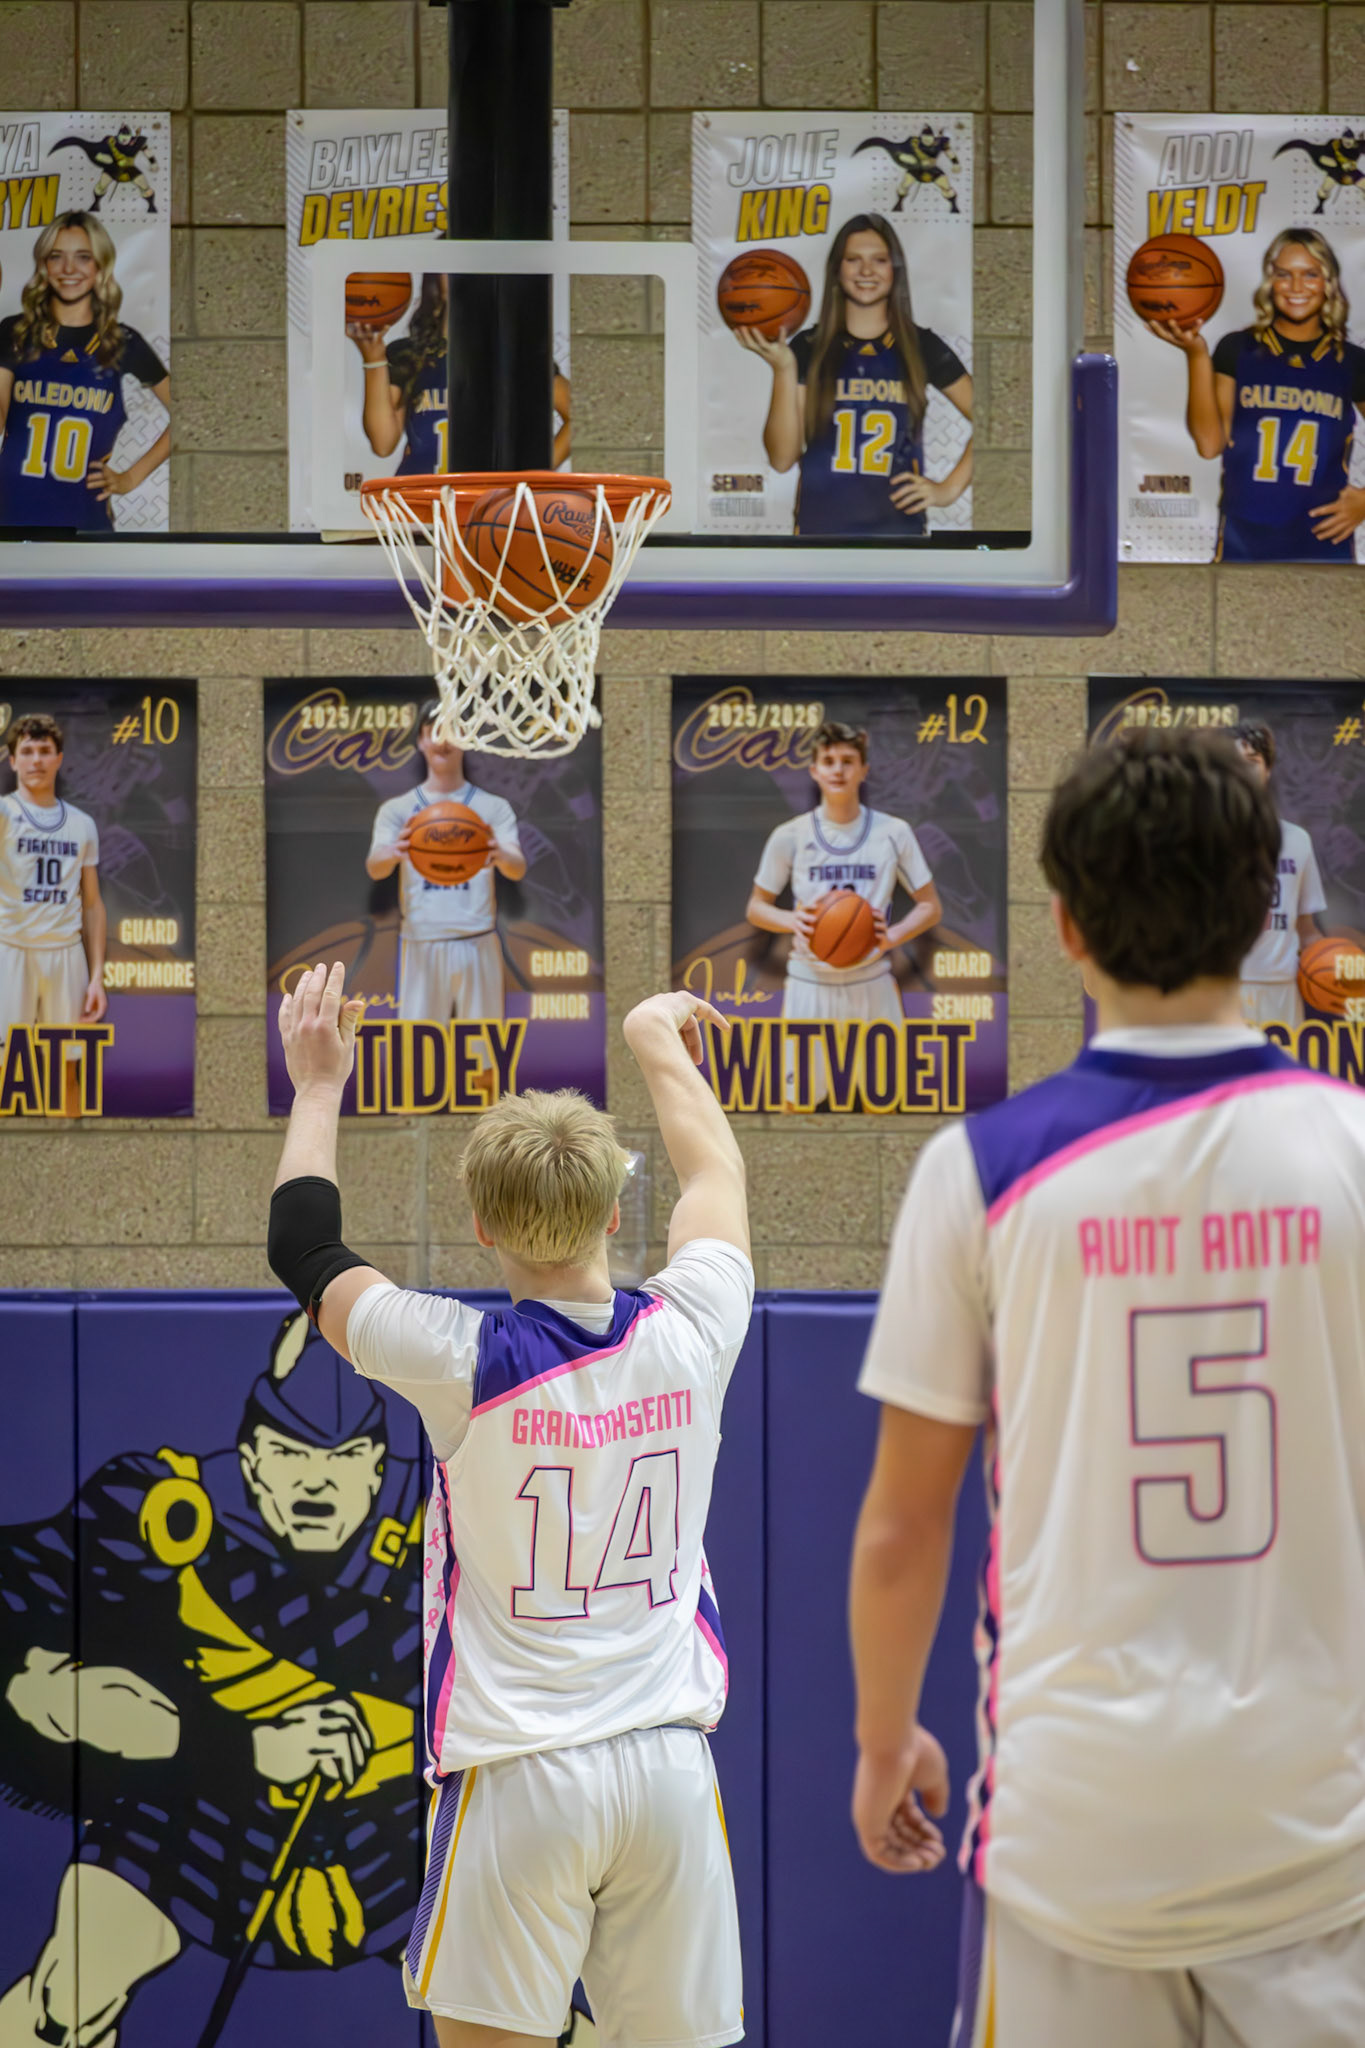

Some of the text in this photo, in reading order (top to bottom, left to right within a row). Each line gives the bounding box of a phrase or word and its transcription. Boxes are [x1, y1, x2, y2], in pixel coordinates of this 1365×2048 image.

[727, 129, 839, 187] JOLIE
[1157, 129, 1254, 186] ADDI
[735, 184, 831, 243] KING
[1147, 180, 1267, 238] VELDT
[1240, 385, 1343, 420] CALEDONIA
[20, 412, 93, 483] 10
[831, 408, 897, 477] 12
[1253, 416, 1319, 486] 14
[711, 474, 764, 493] SENIOR
[1138, 475, 1192, 494] JUNIOR
[111, 695, 180, 744] #10
[301, 705, 413, 730] 2025/2026
[708, 703, 820, 728] 2025/2026
[915, 693, 989, 744] #12
[36, 857, 62, 885] 10
[120, 918, 178, 945] GUARD
[103, 961, 195, 988] SOPHMORE
[531, 951, 589, 977] GUARD
[933, 951, 992, 978] GUARD
[531, 994, 589, 1020] JUNIOR
[932, 995, 994, 1020] SENIOR
[355, 1018, 528, 1114] TIDEY
[702, 1016, 976, 1113] WITVOET
[1078, 1206, 1321, 1278] AUNT ANITA
[1130, 1300, 1277, 1566] 5
[510, 1448, 680, 1619] 14
